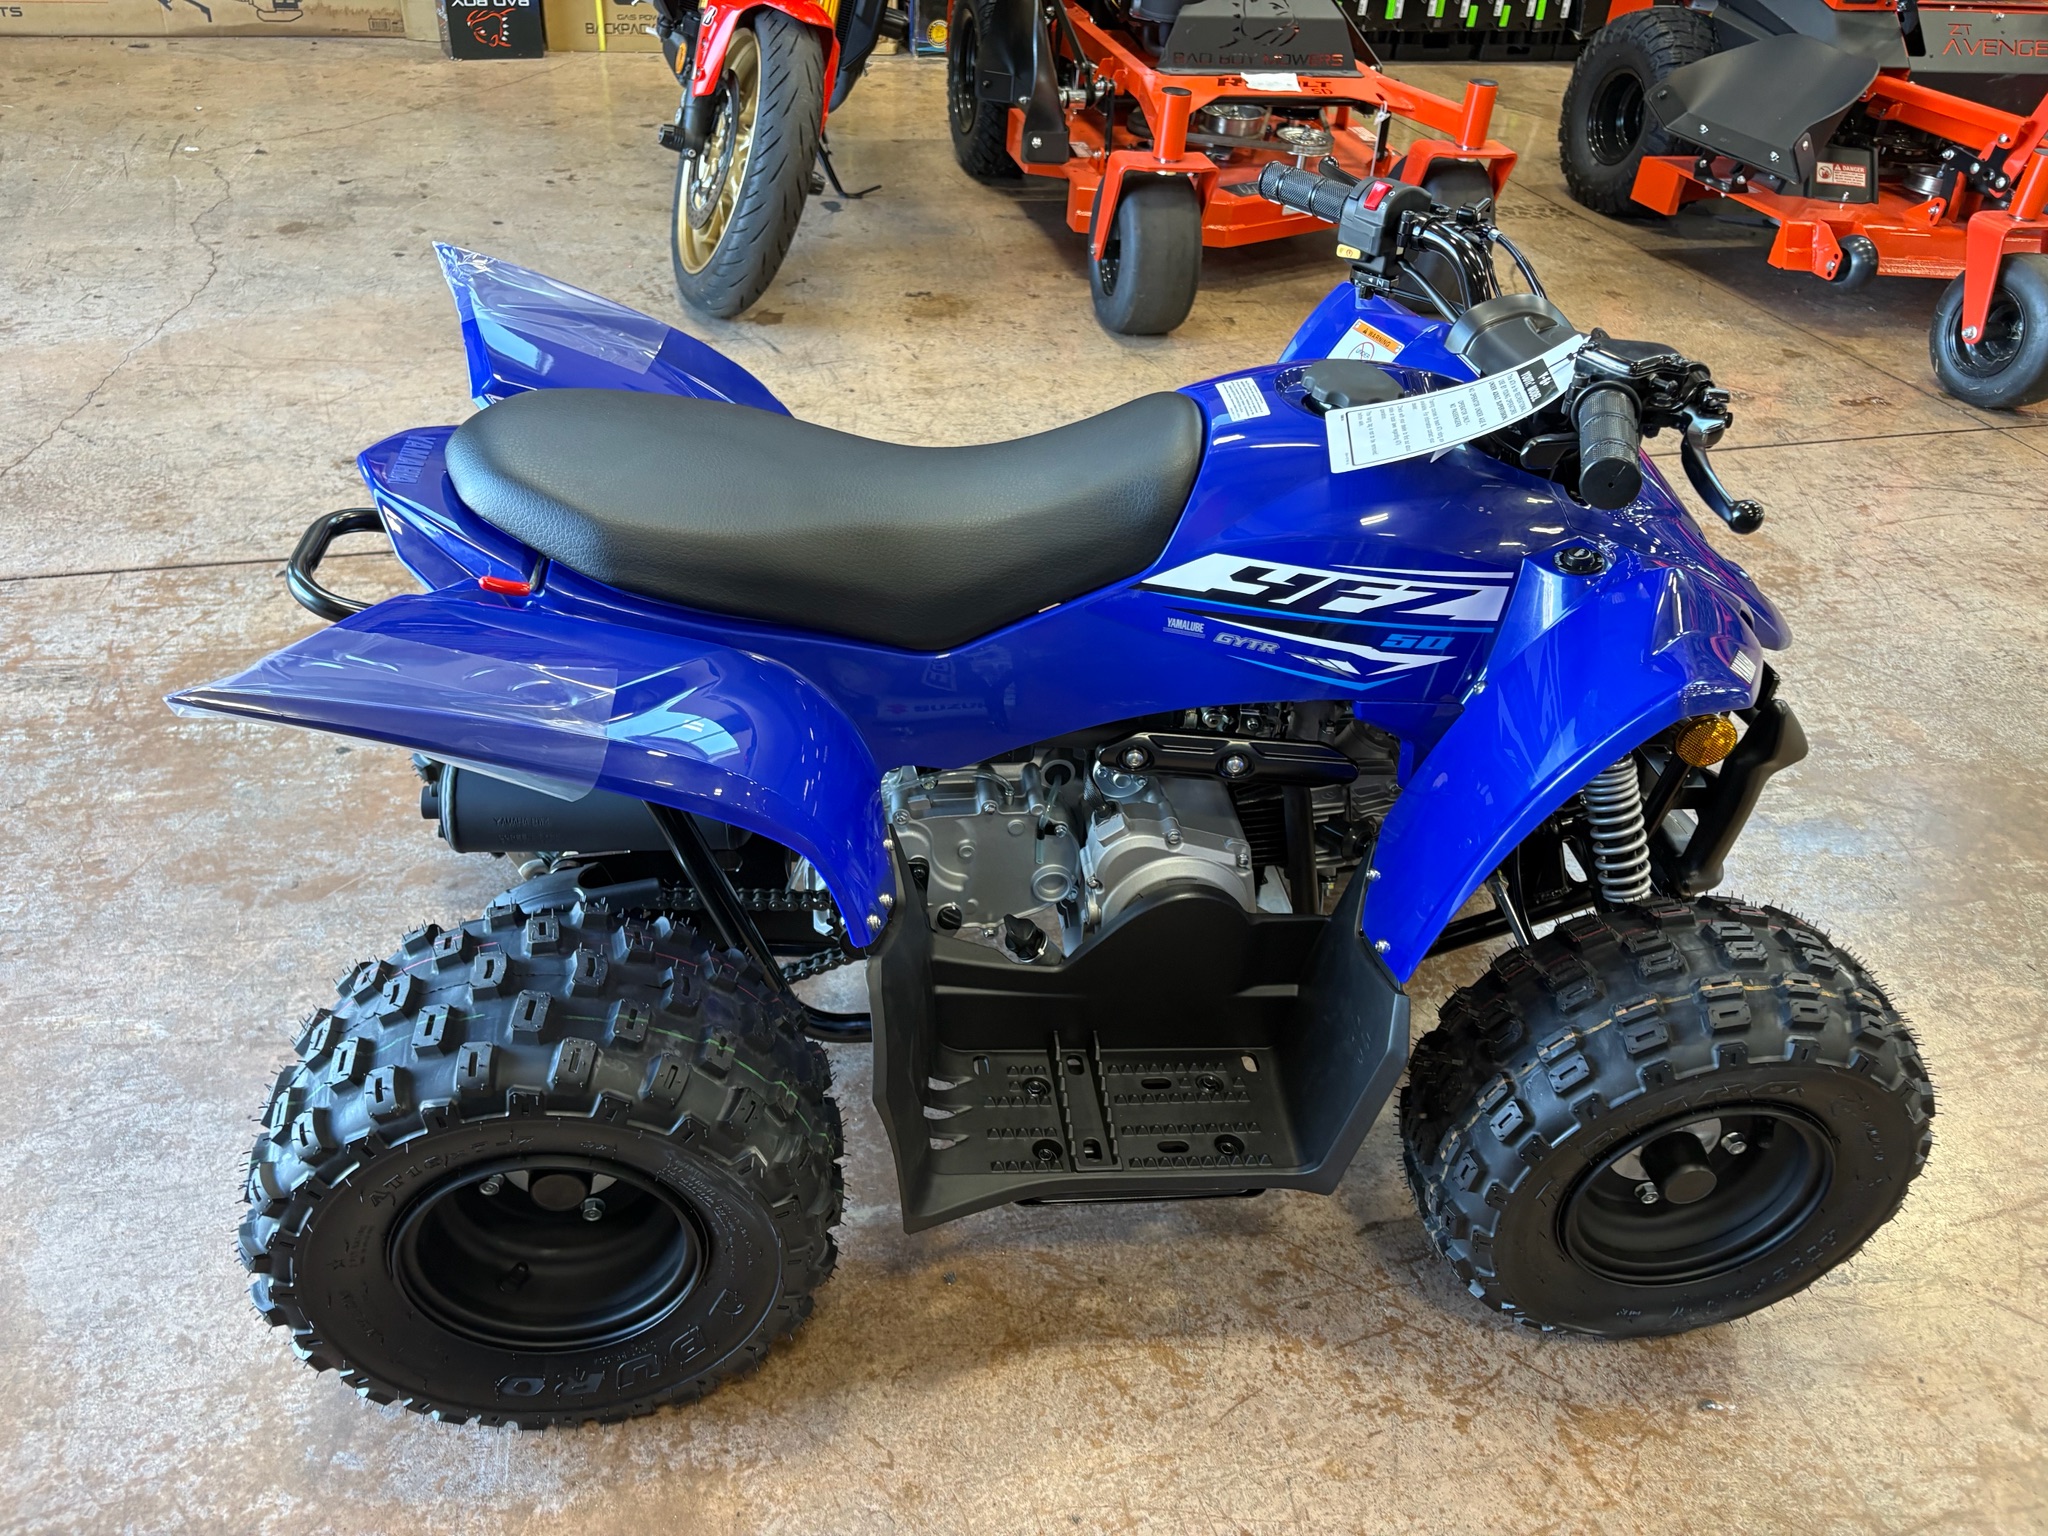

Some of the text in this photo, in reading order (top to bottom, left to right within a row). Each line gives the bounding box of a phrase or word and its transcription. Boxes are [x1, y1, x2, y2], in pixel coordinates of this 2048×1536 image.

[1948, 23, 1972, 35] ZT
[1173, 52, 1343, 66] BAD BOY MOWERS
[1368, 330, 1391, 348] WARNING
[1526, 385, 1543, 402] MODEL
[387, 435, 437, 484] YAMAHA
[1198, 562, 1490, 621] YFZ
[1167, 617, 1205, 633] YAMALUBE
[1213, 632, 1281, 655] GYTR
[1380, 633, 1455, 650] 50
[495, 1326, 706, 1397] DURO
